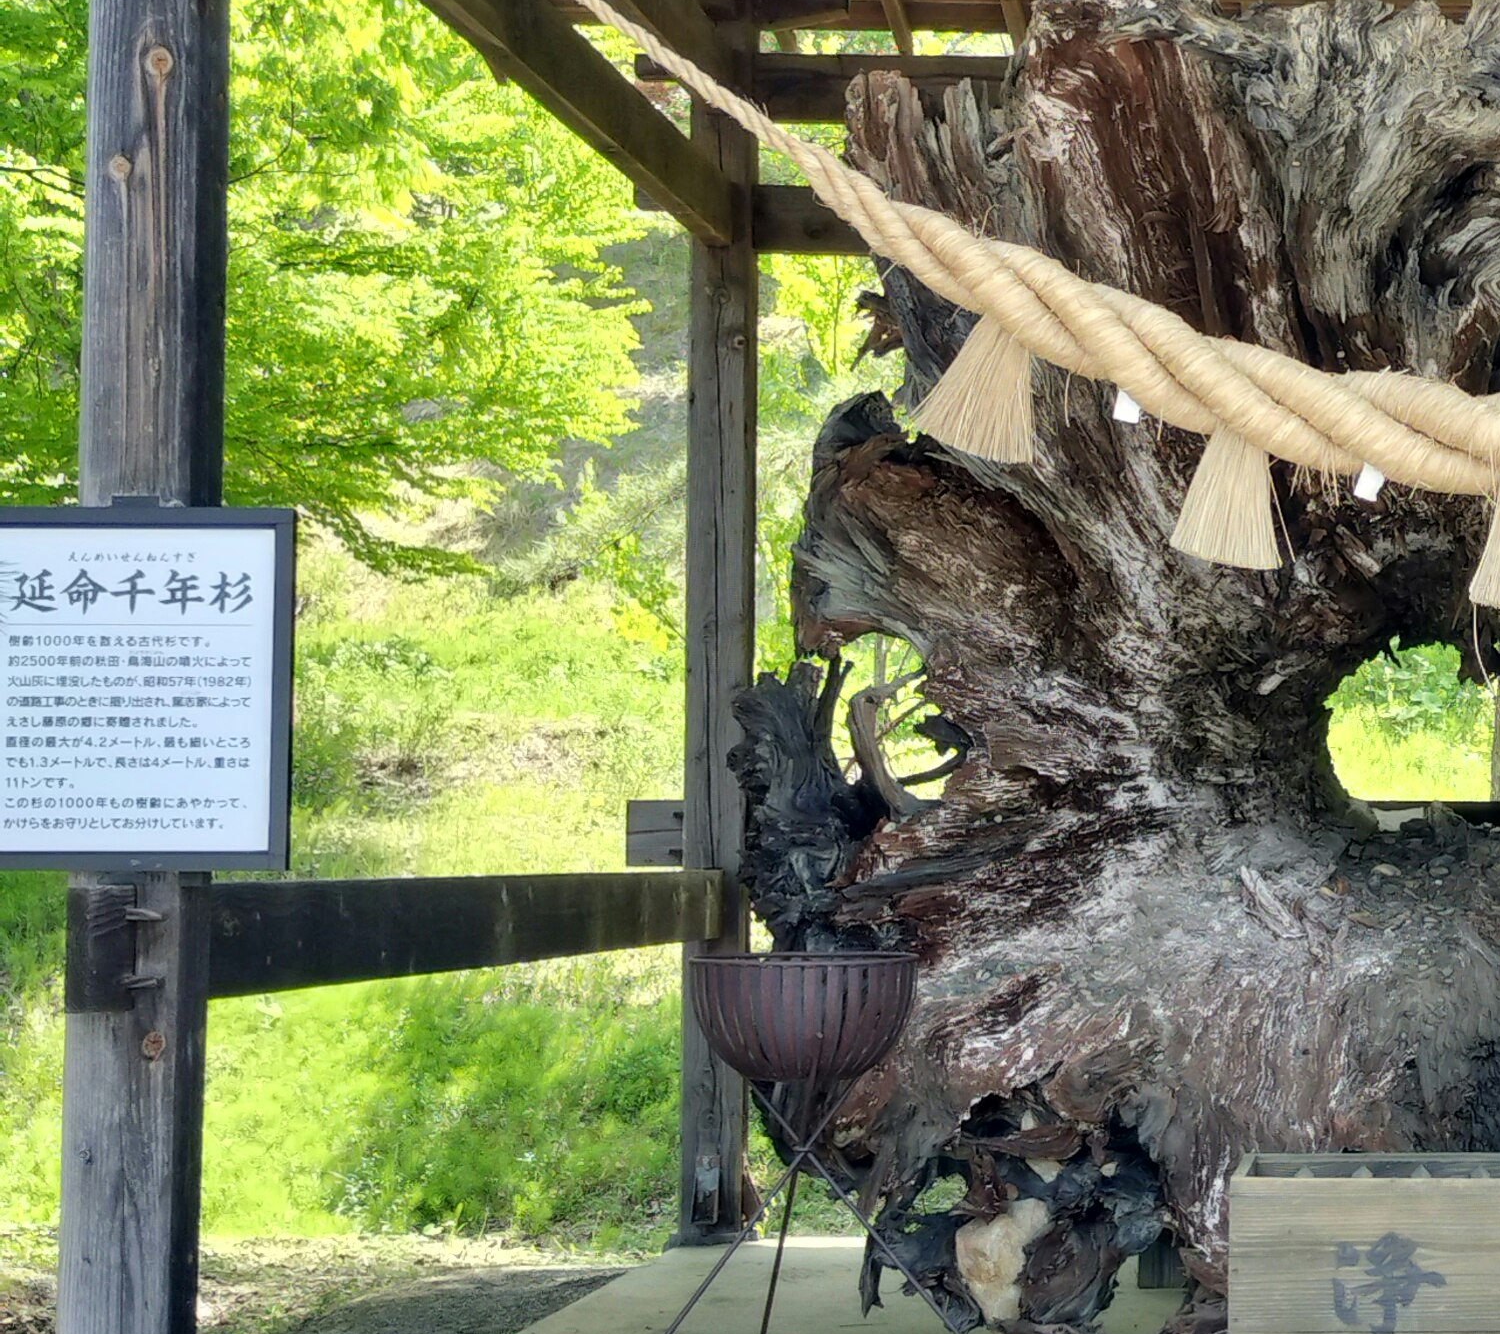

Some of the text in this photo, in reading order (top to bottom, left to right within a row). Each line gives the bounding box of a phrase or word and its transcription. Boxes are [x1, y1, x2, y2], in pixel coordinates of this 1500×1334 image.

[10, 568, 253, 615] 延命千年杉
[5, 777, 75, 789] 11トンです。
